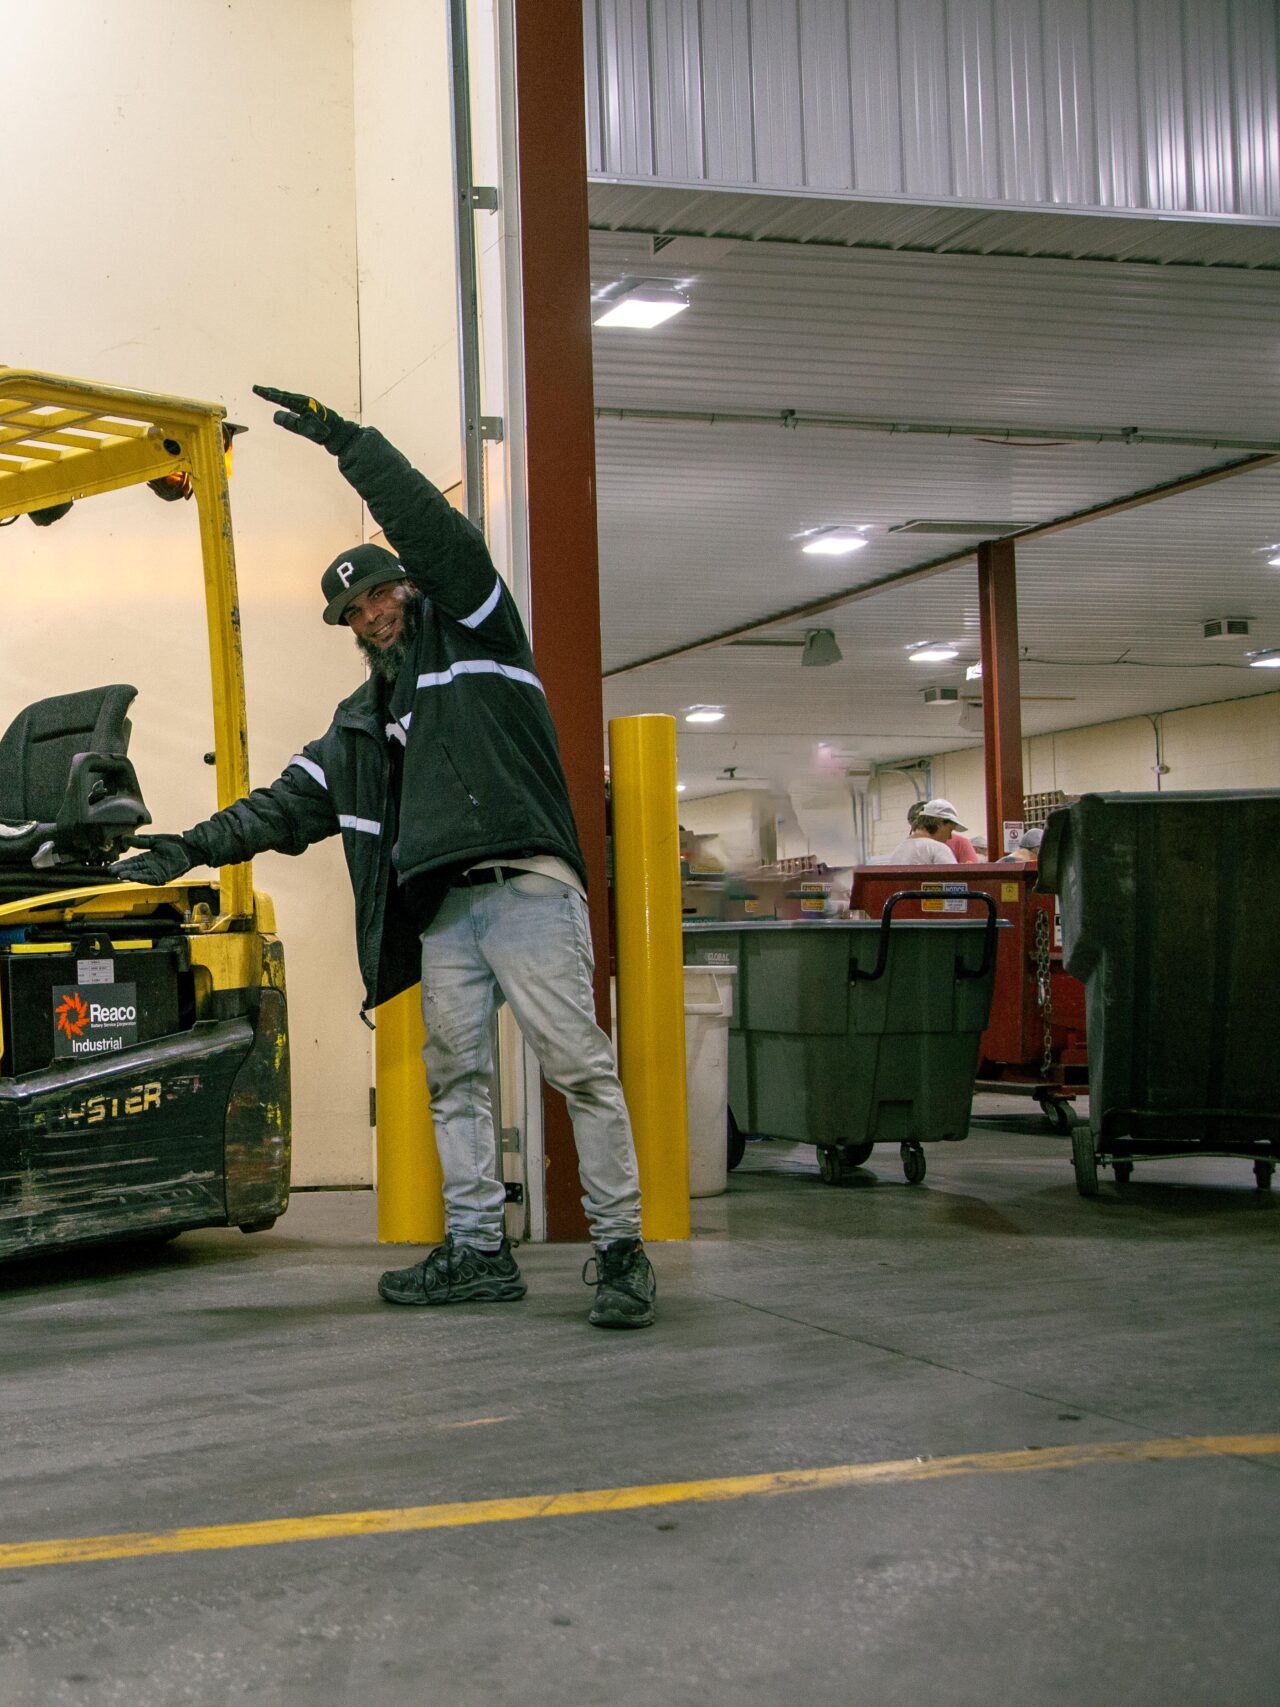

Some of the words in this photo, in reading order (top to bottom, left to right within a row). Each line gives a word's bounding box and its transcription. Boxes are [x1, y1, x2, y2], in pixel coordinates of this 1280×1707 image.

[336, 561, 354, 589] P
[89, 1003, 136, 1022] Reaco
[72, 1037, 123, 1053] Industrial
